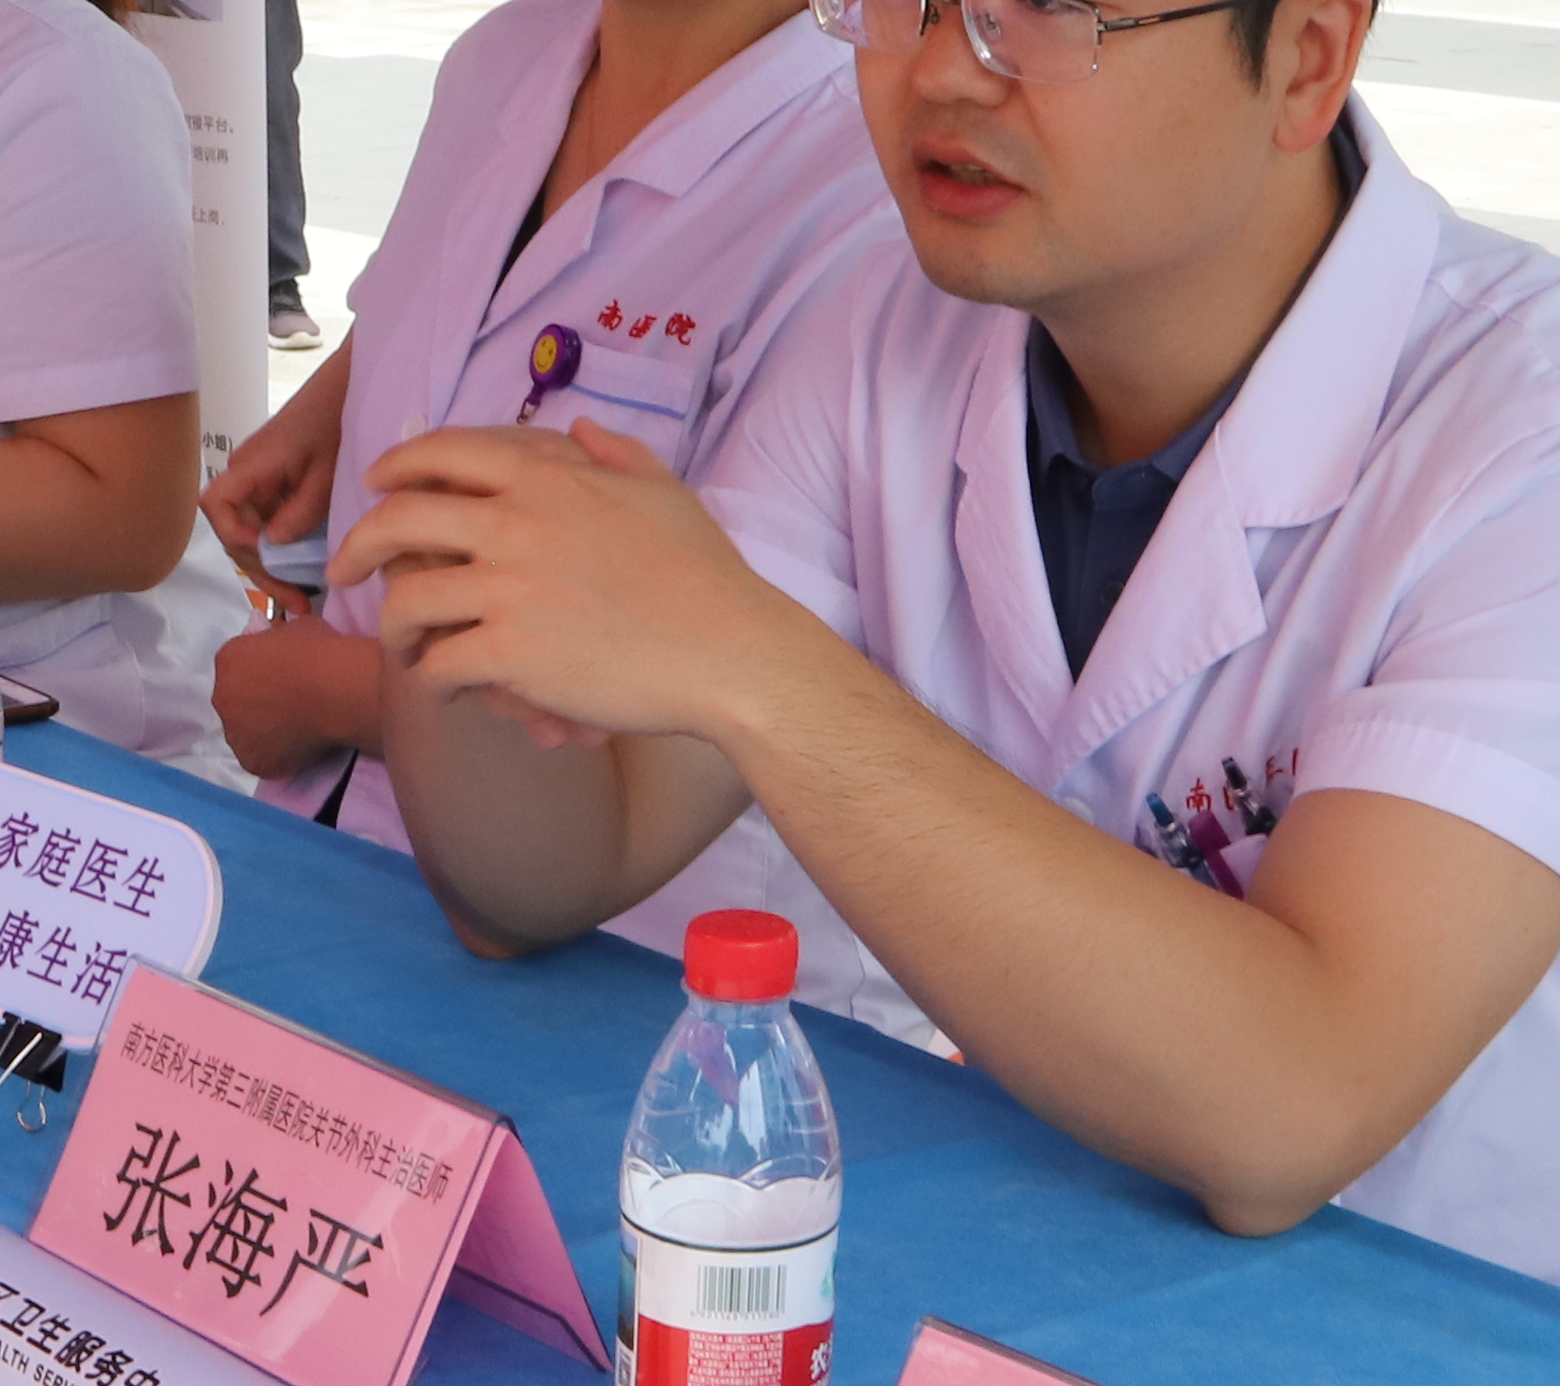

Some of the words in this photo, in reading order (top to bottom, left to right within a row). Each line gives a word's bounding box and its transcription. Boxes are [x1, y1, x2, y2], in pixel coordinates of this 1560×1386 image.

[119, 1021, 455, 1207] 南方医科大学第三附属医院关节外科主治医师
[102, 1121, 385, 1319] 张海严
